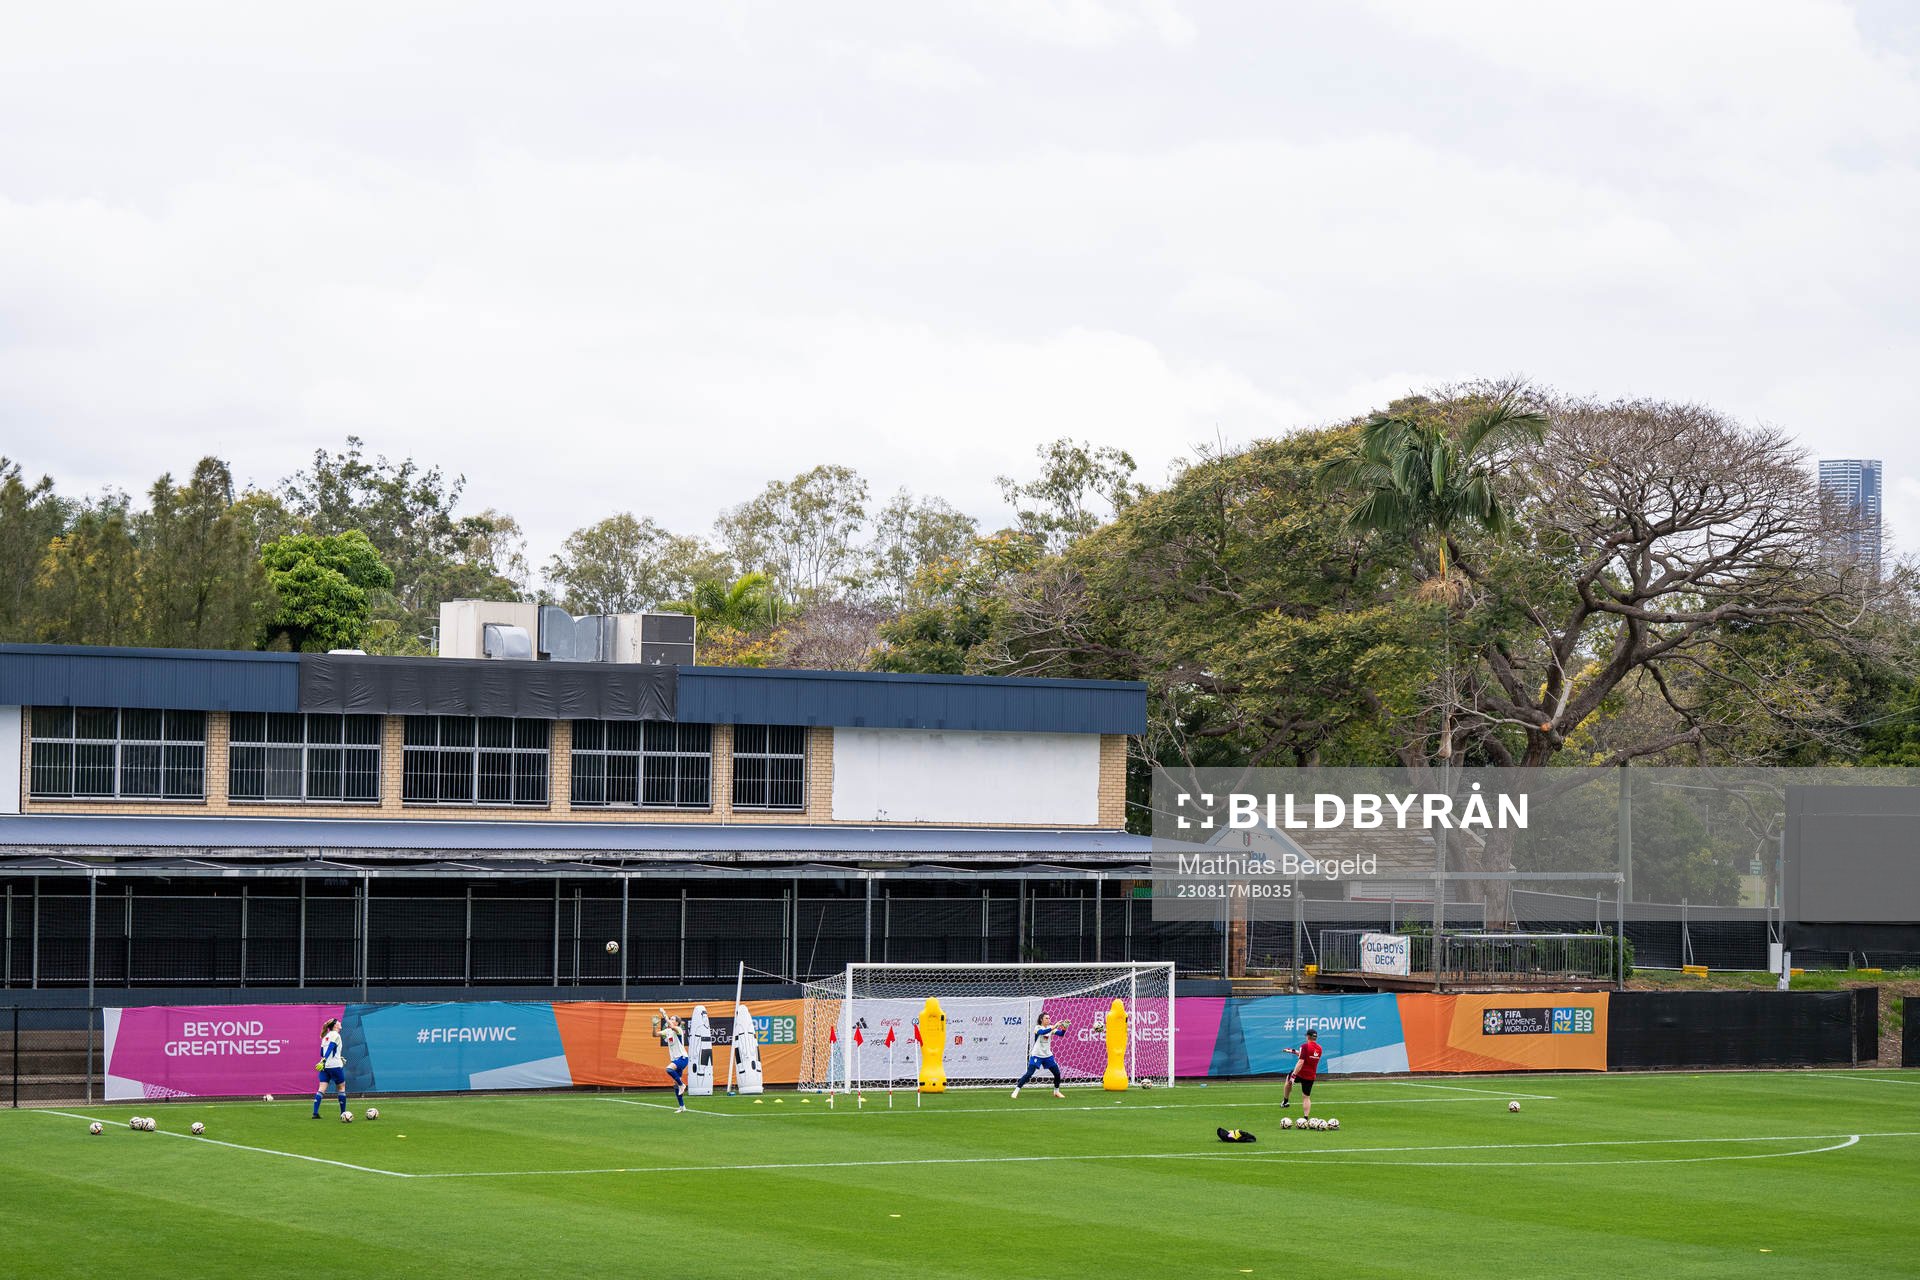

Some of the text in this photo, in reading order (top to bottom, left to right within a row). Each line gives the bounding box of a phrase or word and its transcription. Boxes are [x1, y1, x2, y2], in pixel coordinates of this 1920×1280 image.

[1366, 942, 1404, 955] OLD BOYS
[1375, 954, 1396, 966] DECK
[1504, 1010, 1521, 1018] FIFA
[1554, 1010, 1571, 1020] AU
[1575, 1010, 1592, 1020] 20
[773, 1018, 794, 1029] 20
[1003, 1016, 1022, 1025] VISA
[1283, 1016, 1367, 1031] #FIFAWWC
[183, 1021, 264, 1037] BEYOND
[1528, 1024, 1543, 1032] CUP
[1554, 1021, 1571, 1031] NZ
[1574, 1021, 1592, 1031] 23
[416, 1026, 517, 1043] #FIFAWWC
[773, 1031, 794, 1042] 23
